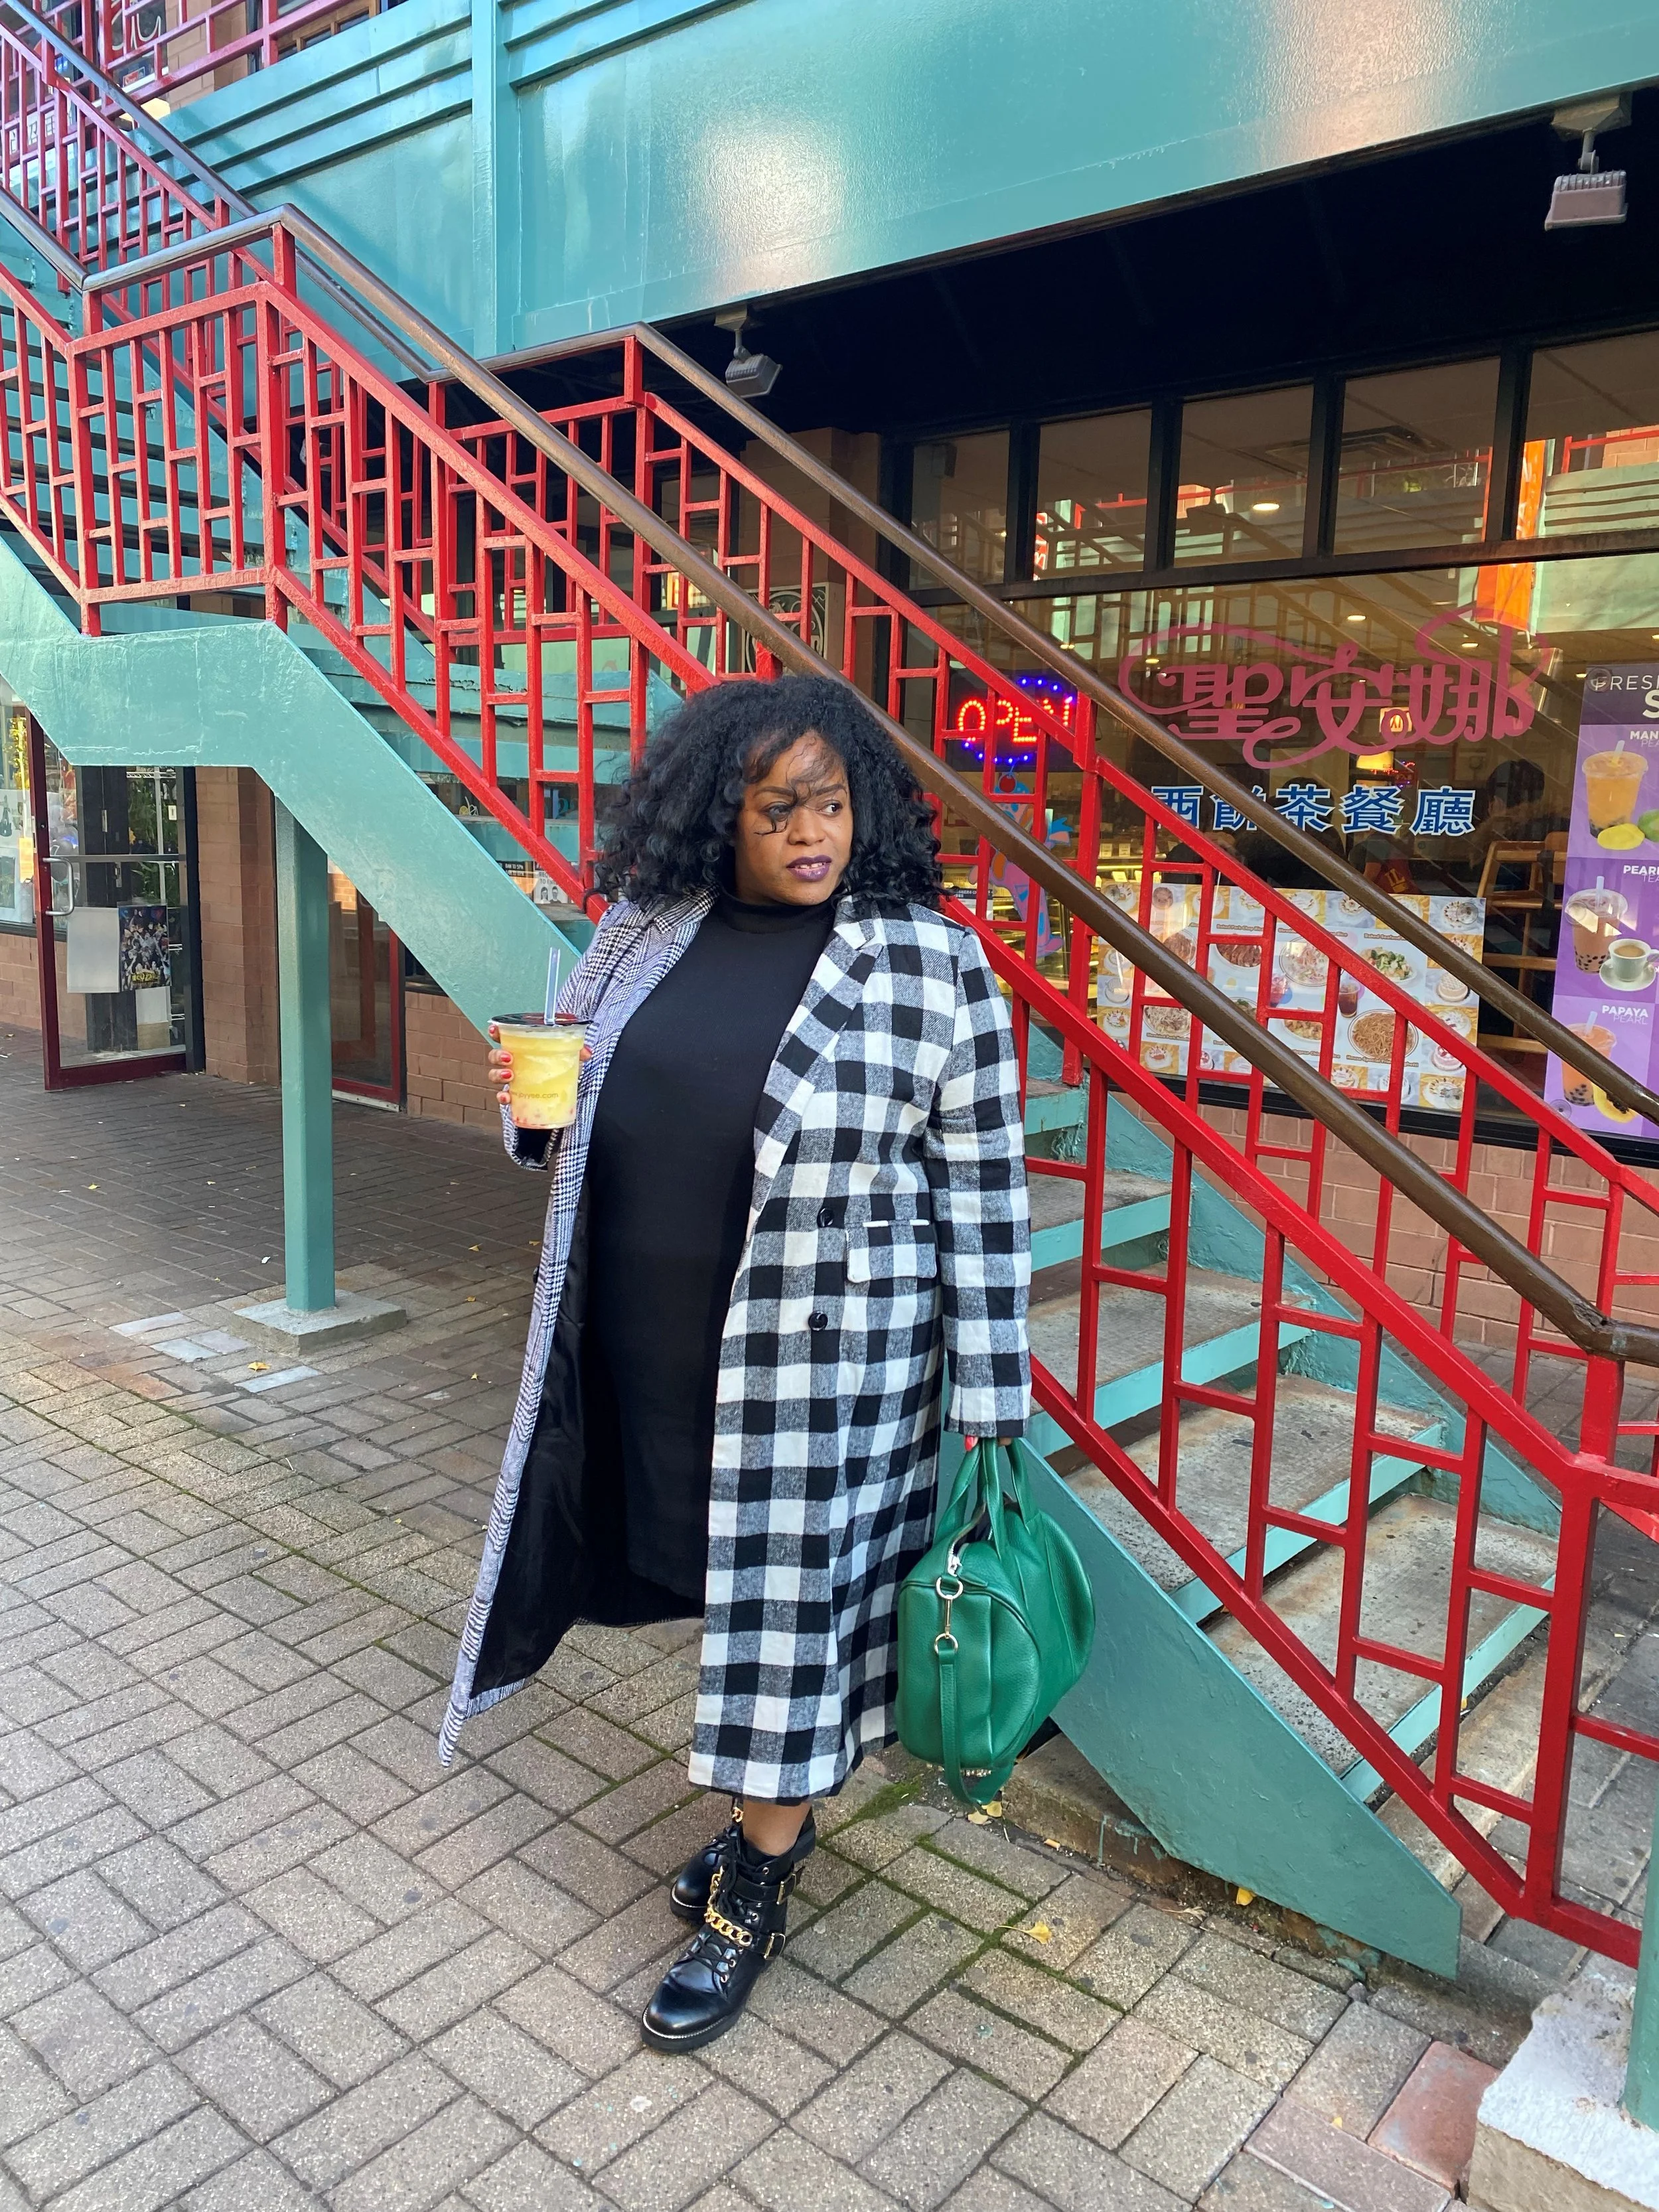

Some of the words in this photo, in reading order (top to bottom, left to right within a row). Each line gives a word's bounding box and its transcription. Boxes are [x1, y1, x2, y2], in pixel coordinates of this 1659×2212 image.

[1595, 674, 1659, 690] FRES
[1602, 1005, 1648, 1017] PAPAYA
[1613, 1014, 1647, 1025] PEARL
